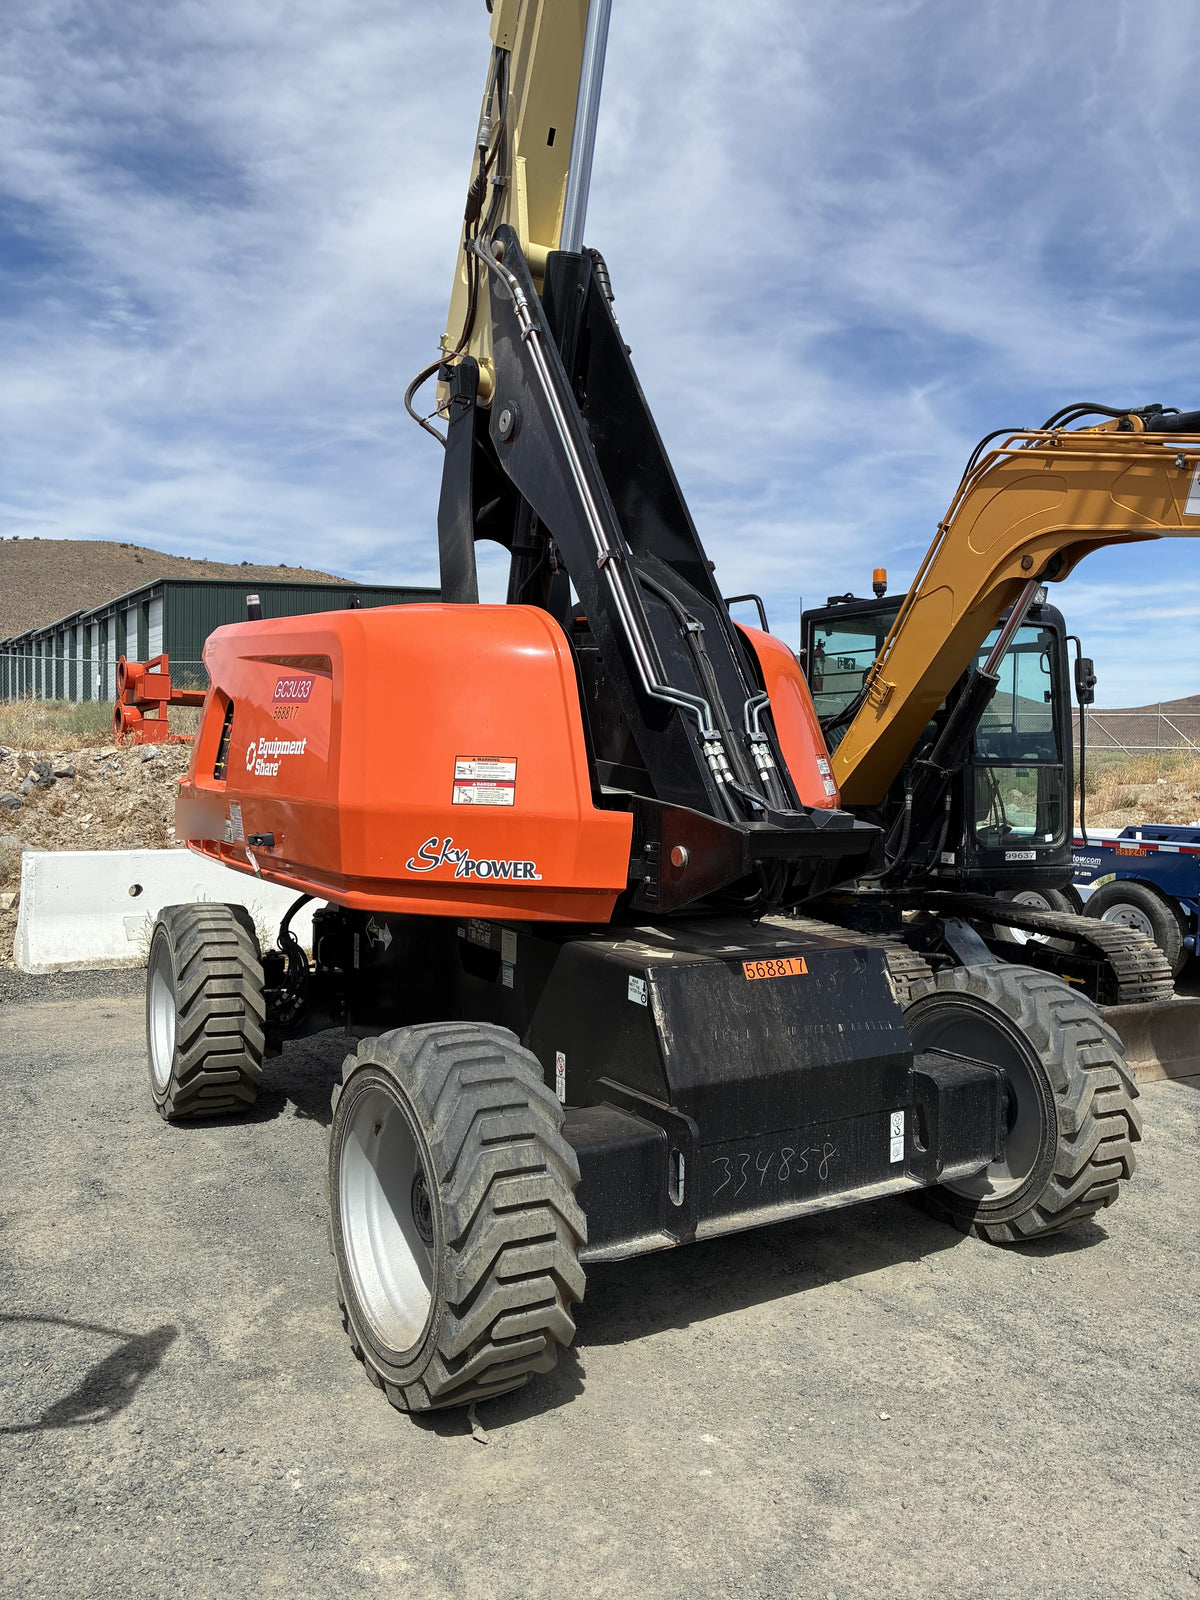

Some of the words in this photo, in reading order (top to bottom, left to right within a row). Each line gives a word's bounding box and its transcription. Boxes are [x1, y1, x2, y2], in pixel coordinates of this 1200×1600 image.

[274, 680, 312, 698] GC3U33
[273, 706, 300, 720] 568817
[257, 737, 307, 759] Equipment
[254, 758, 279, 776] Share
[1005, 852, 1035, 860] 99637
[745, 957, 804, 979] 568817
[712, 1142, 837, 1198] 334858
